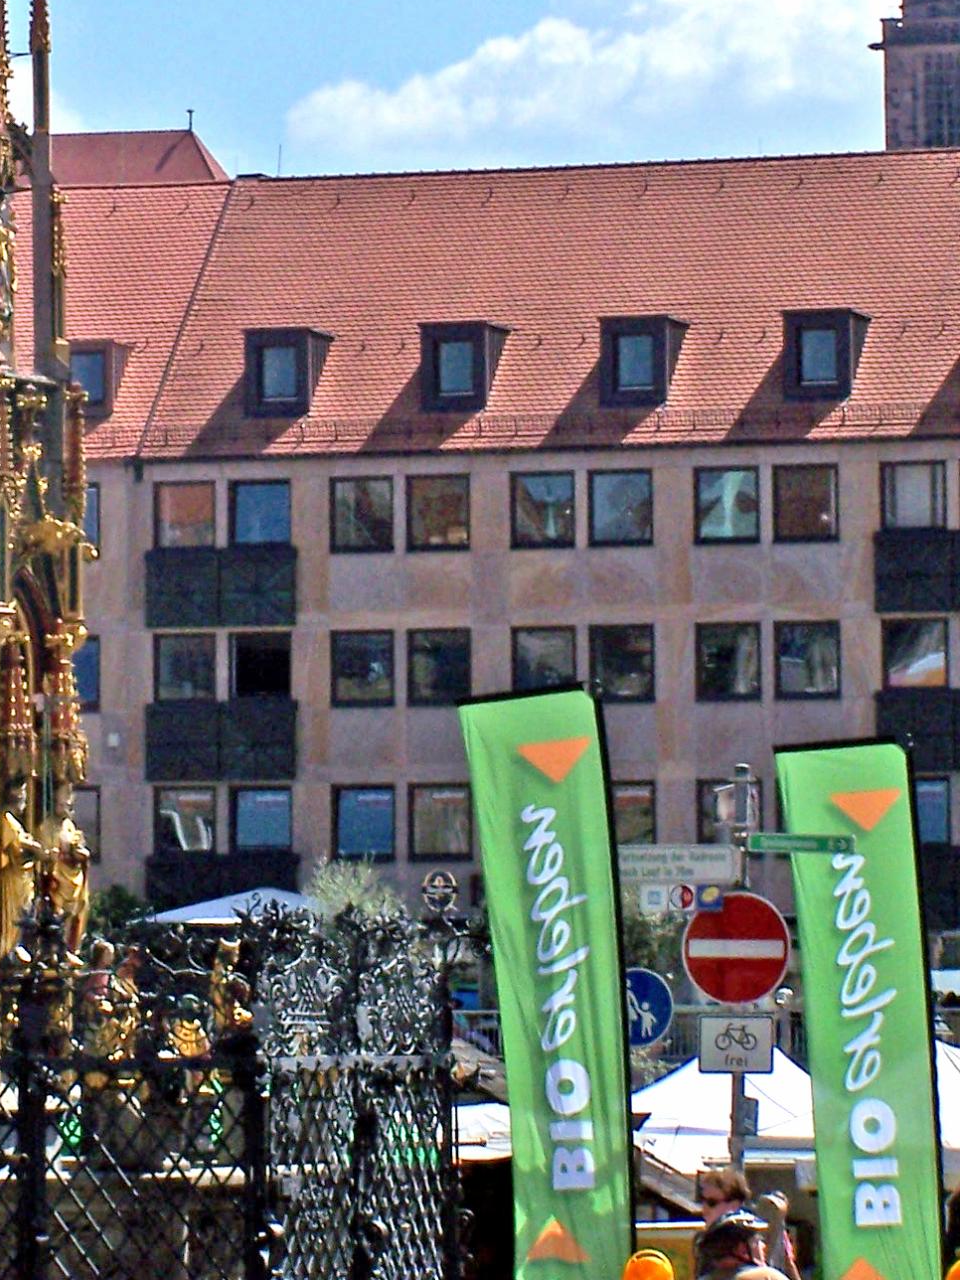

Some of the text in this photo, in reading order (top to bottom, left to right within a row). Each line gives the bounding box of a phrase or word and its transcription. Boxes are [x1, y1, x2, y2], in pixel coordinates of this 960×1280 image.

[520, 803, 596, 1192] BIO erleben
[724, 1053, 749, 1068] frei
[831, 852, 903, 1227] BIO erleben
